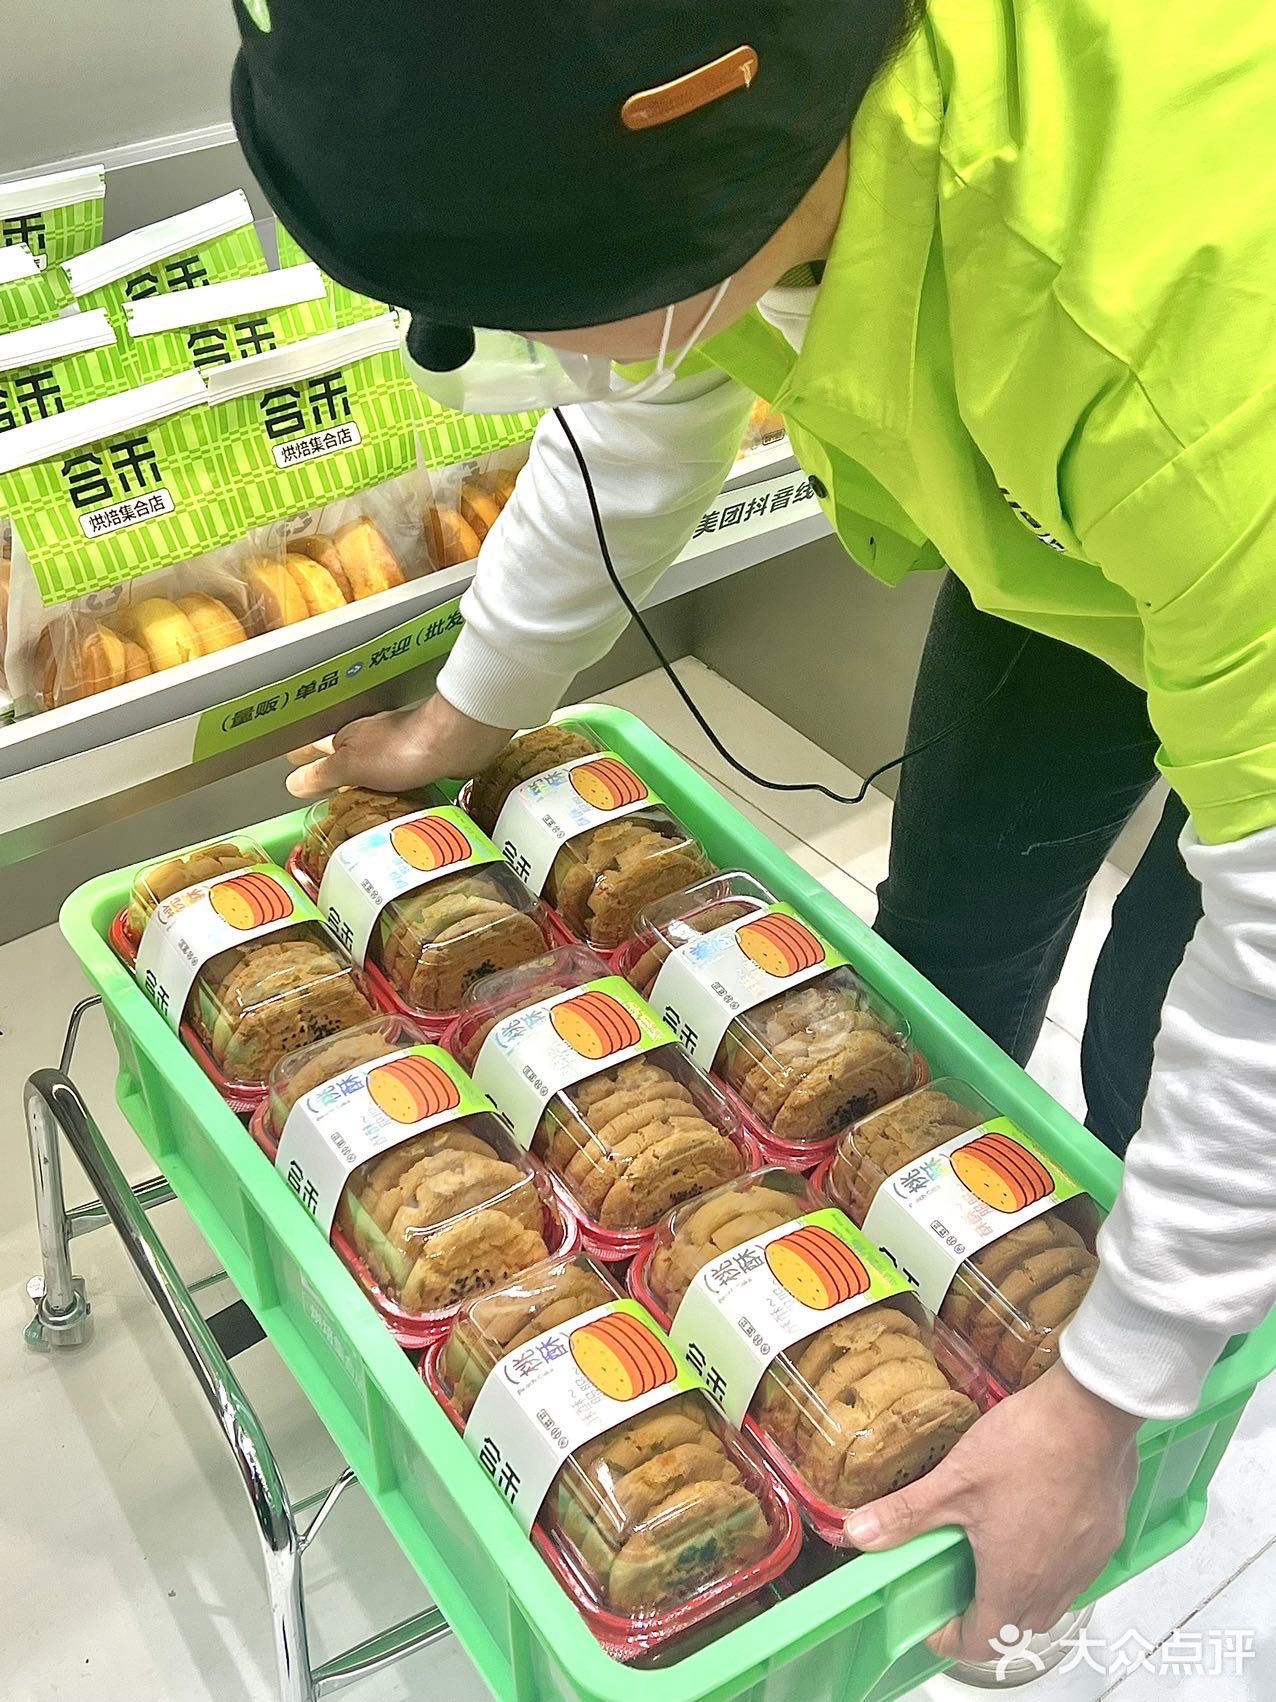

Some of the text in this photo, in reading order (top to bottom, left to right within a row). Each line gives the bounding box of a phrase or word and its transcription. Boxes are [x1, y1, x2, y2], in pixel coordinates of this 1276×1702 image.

[259, 371, 352, 440] 合禾
[61, 435, 163, 509] 合禾
[280, 427, 354, 464] 烘焙集合店
[88, 496, 166, 533] 烘焙集合店
[286, 1160, 319, 1215] 合禾
[479, 1437, 521, 1505] 合禾
